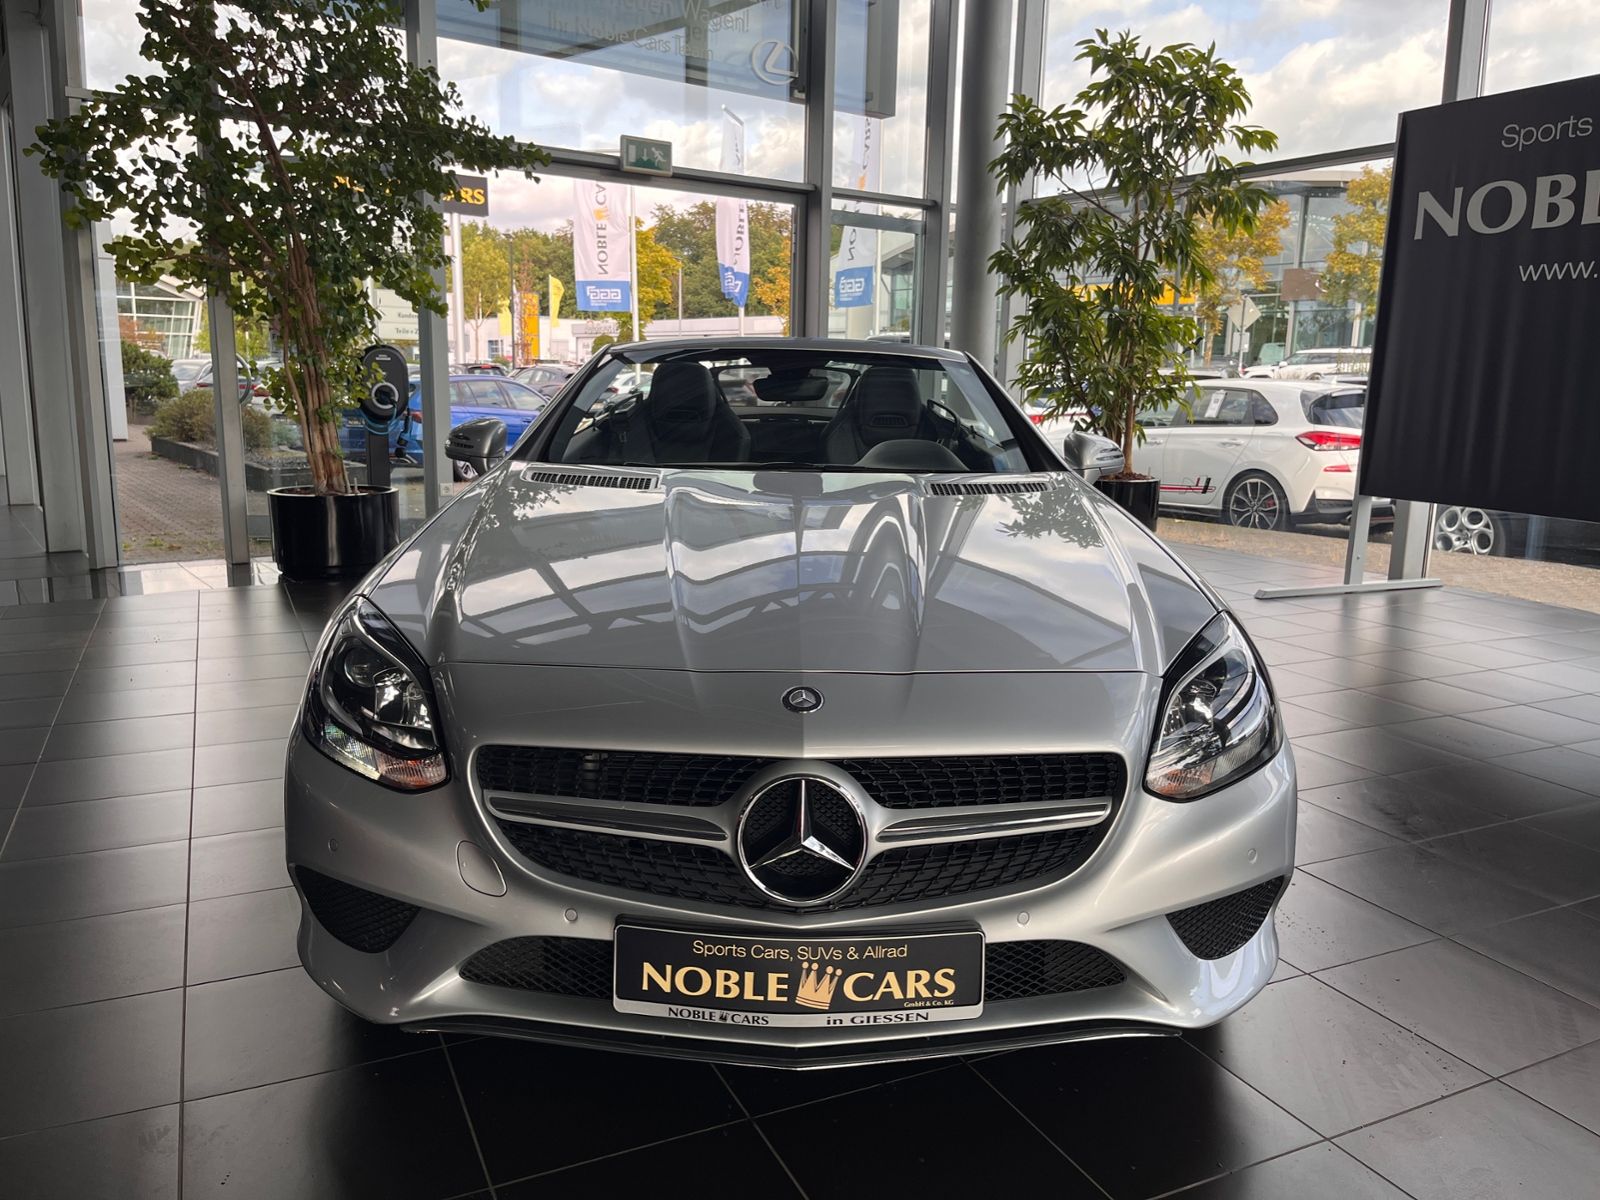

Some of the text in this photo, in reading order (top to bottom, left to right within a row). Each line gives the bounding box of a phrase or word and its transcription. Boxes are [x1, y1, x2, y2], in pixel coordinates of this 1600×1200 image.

[1501, 116, 1593, 152] Sports
[1518, 260, 1599, 282] www.
[692, 939, 908, 962] Sports Cars, SUVs & Allrad
[642, 961, 956, 1002] NOBLE CARS
[668, 1007, 929, 1026] NOBLE CARS in GIESSEN
